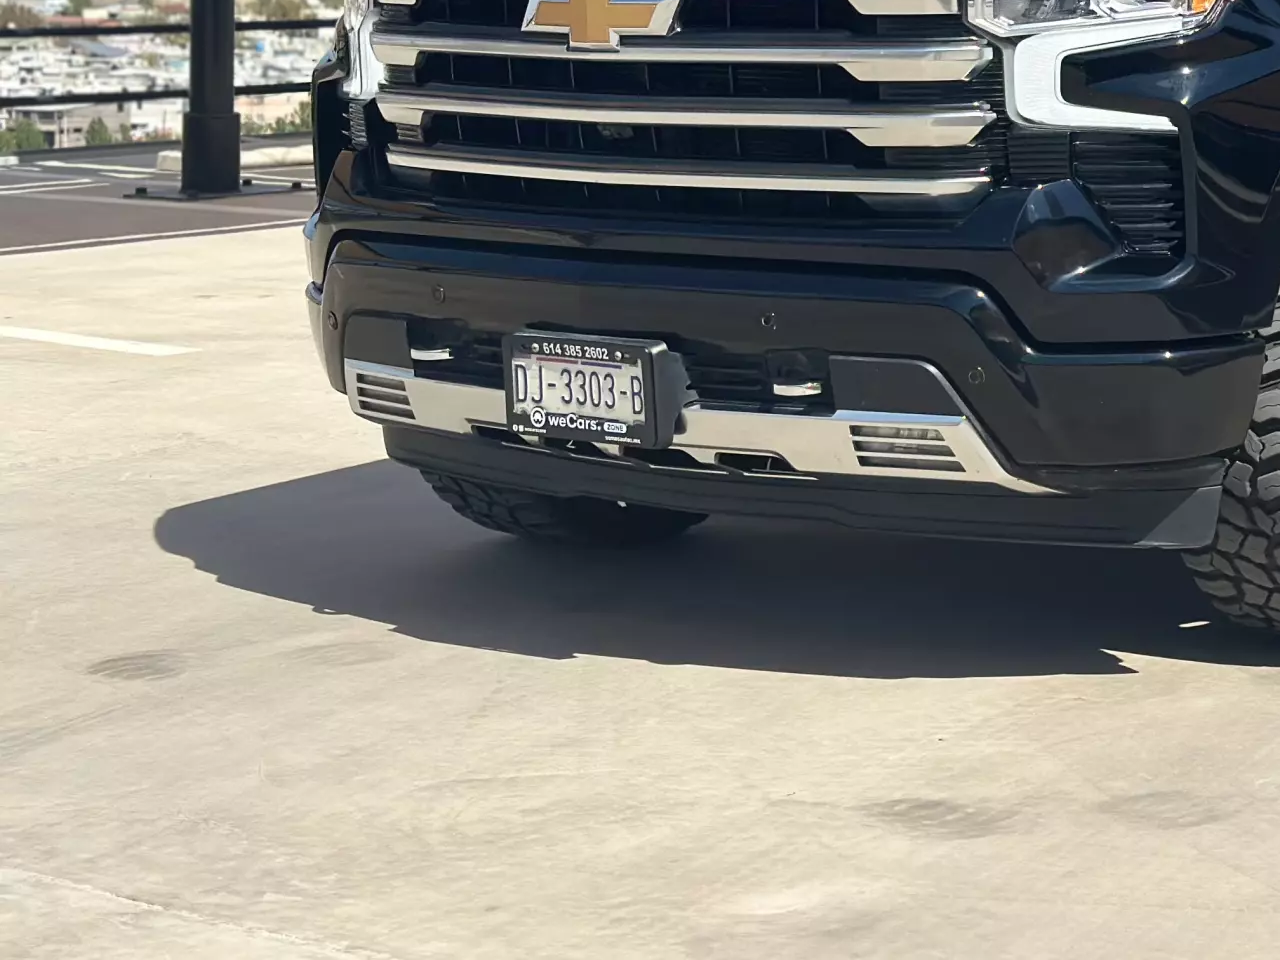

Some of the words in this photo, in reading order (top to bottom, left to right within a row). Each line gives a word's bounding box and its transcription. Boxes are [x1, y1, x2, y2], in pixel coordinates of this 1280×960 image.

[542, 342, 562, 356] 614
[563, 344, 583, 358] 385
[584, 346, 609, 360] 2602
[514, 363, 644, 415] DJ-3303-B
